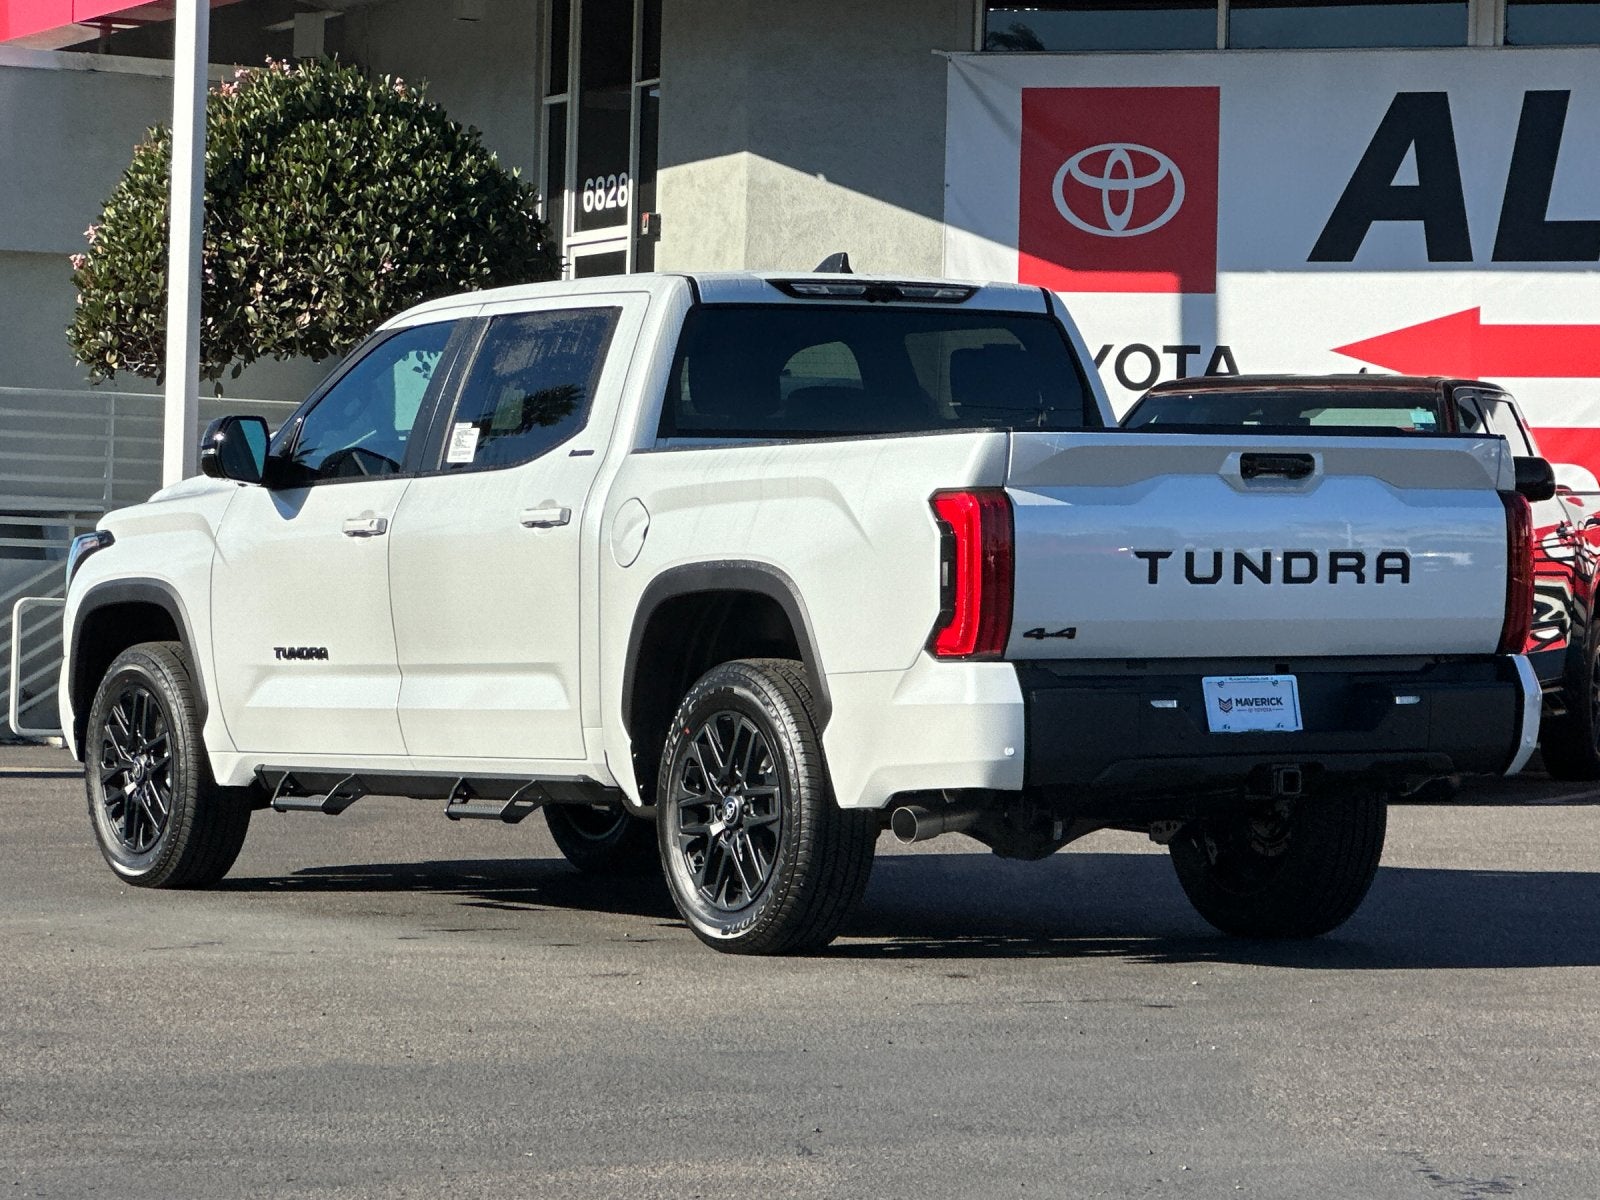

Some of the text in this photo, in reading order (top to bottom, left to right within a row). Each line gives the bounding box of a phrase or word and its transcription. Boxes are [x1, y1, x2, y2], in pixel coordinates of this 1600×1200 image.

[583, 172, 629, 213] 6828
[1135, 550, 1410, 585] TUNDRA
[273, 647, 329, 660] TUNDRA
[1235, 697, 1283, 706] MAVERICK
